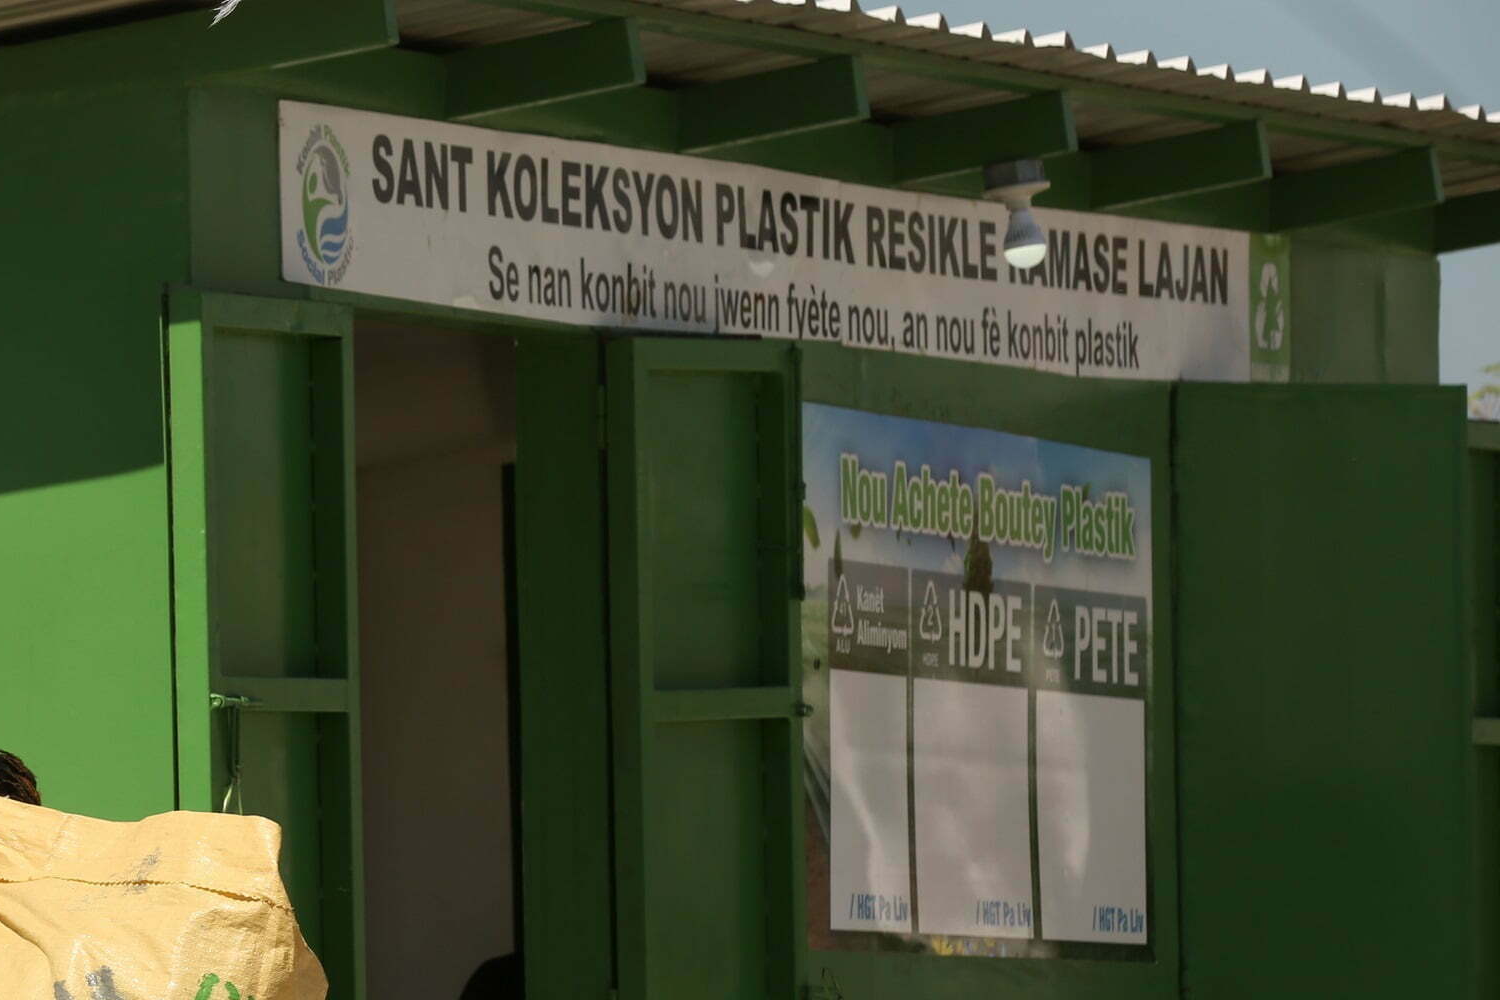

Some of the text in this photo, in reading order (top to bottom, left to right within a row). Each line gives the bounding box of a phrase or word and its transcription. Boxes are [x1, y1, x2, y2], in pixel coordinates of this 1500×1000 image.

[371, 133, 473, 212] SANT
[486, 151, 703, 243] KOLEKSYON
[716, 183, 855, 264] PLASTIK
[866, 205, 998, 281] RESIKLE
[1137, 239, 1229, 306] LAJAN
[487, 245, 1140, 376] Se nan konbit nou jwenn fyète nou, an nou fè konbit plastik
[839, 453, 1137, 562] Nou Achete Boutey Plastik
[949, 589, 1023, 672] HDPE
[1074, 605, 1139, 687] PETE
